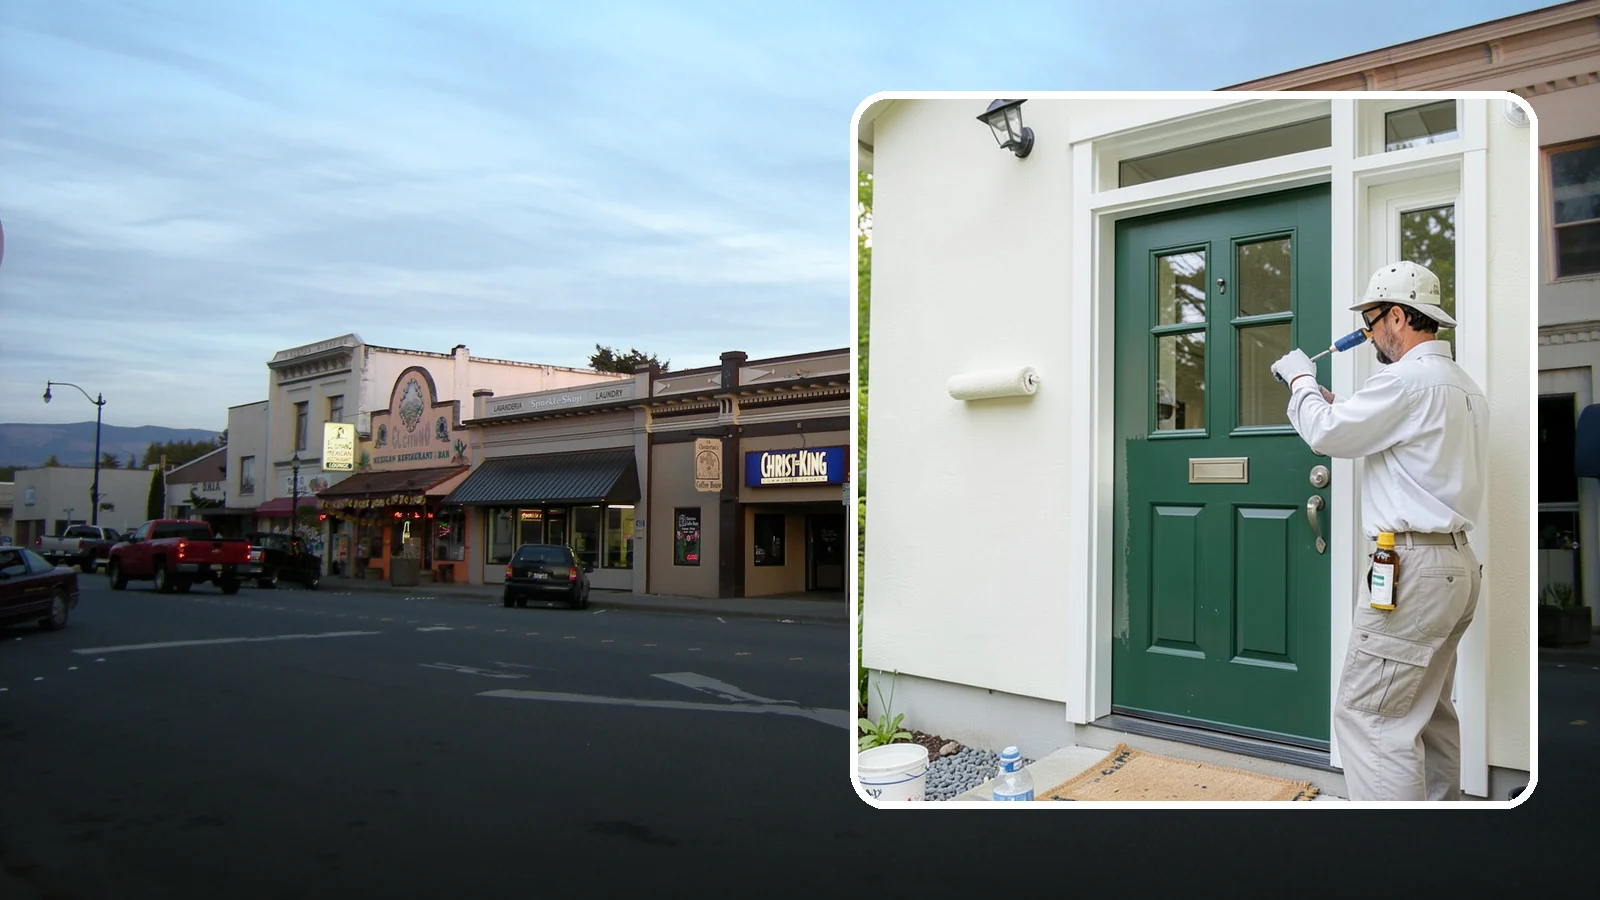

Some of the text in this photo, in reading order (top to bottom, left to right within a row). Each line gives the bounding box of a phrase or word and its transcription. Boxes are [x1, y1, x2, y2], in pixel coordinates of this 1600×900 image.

[562, 394, 582, 404] Shop
[595, 389, 623, 400] LAUNDRY
[493, 402, 522, 412] LAVANDERIA
[373, 450, 449, 464] MEXICAN RESTAURANT BAR
[761, 450, 827, 477] CHRIST KING
